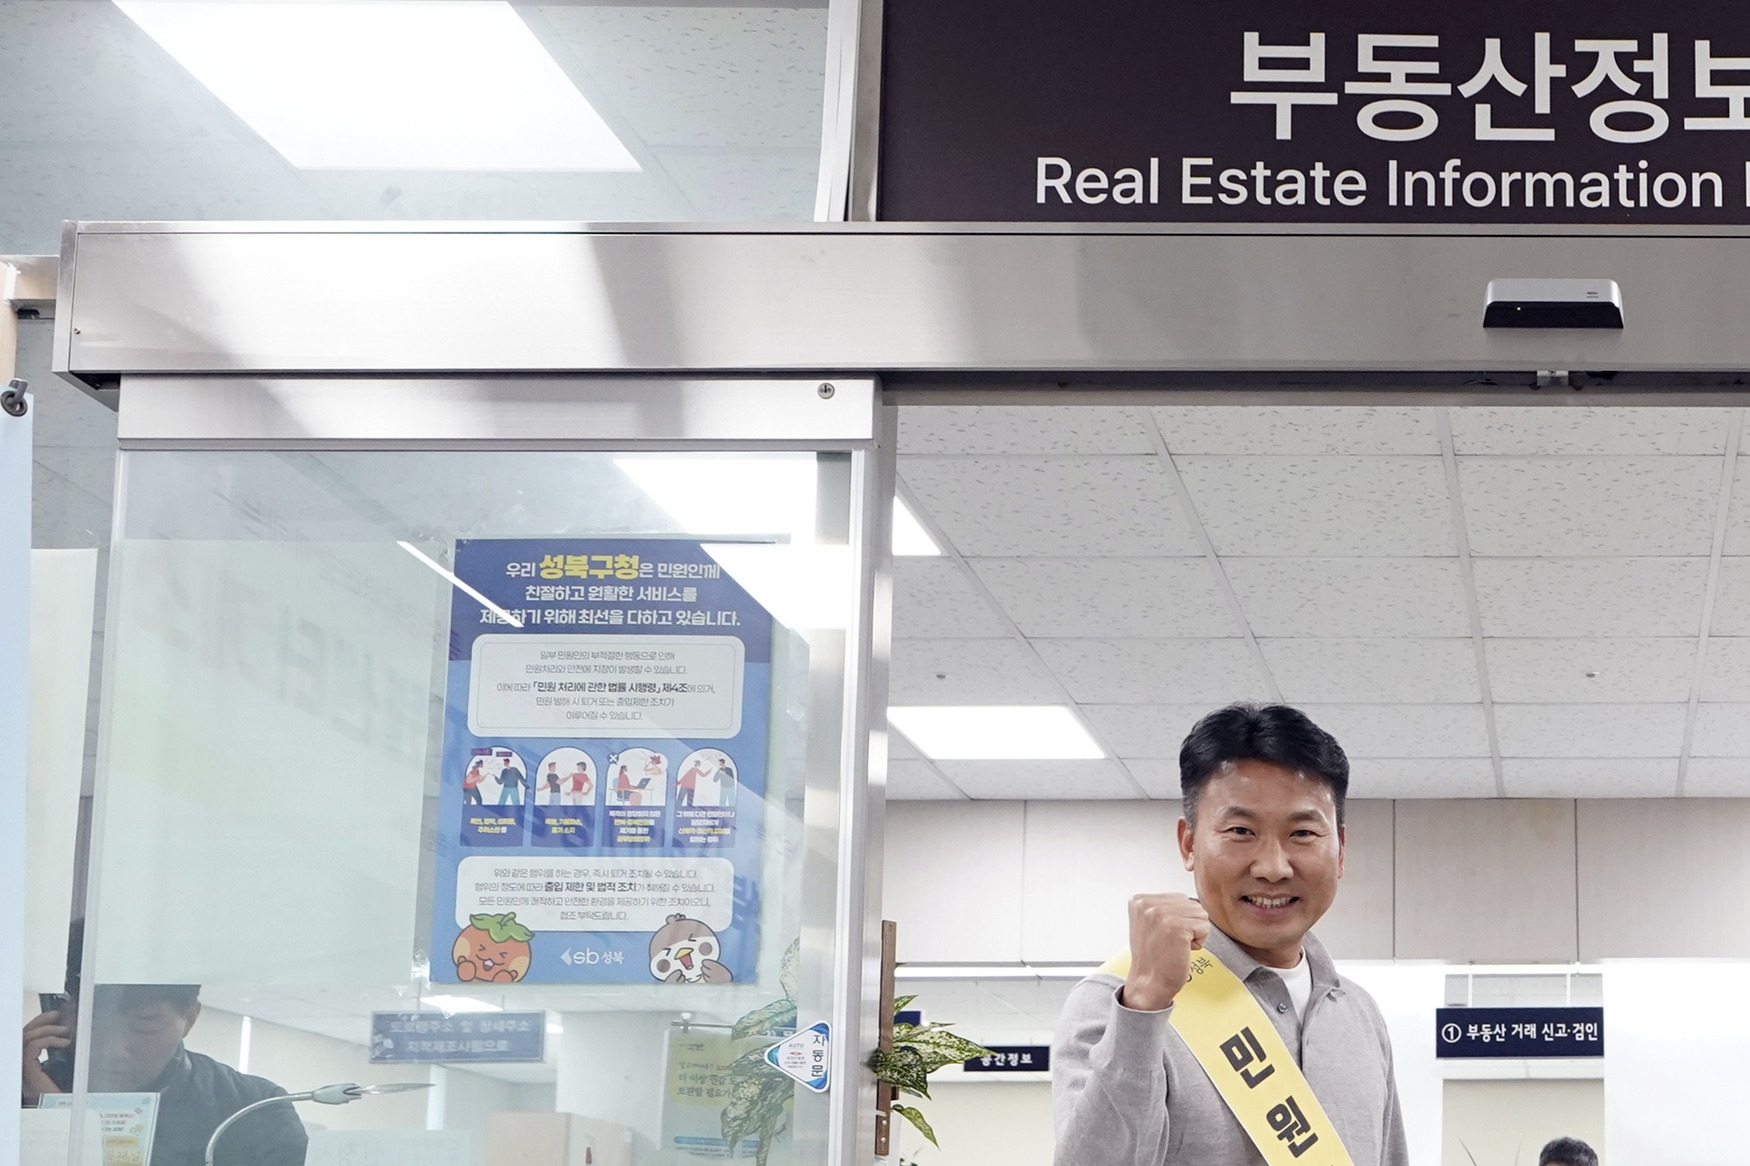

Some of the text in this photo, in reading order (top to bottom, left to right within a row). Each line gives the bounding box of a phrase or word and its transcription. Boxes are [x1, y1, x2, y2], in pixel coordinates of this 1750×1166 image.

[1036, 156, 1160, 204] Real
[1181, 156, 1367, 206] Estate
[1388, 158, 1723, 208] Information
[505, 554, 721, 580] 우리 성북구청은 민원인께
[525, 585, 698, 602] 친절하고 원활한 서비스를
[543, 609, 576, 626] 위해
[578, 609, 624, 626] 최선을
[627, 609, 673, 626] 다하고
[675, 609, 741, 626] 있습니다.
[573, 948, 625, 965] sb 성북
[1466, 1023, 1507, 1043] 부동산
[1511, 1022, 1537, 1040] 거래
